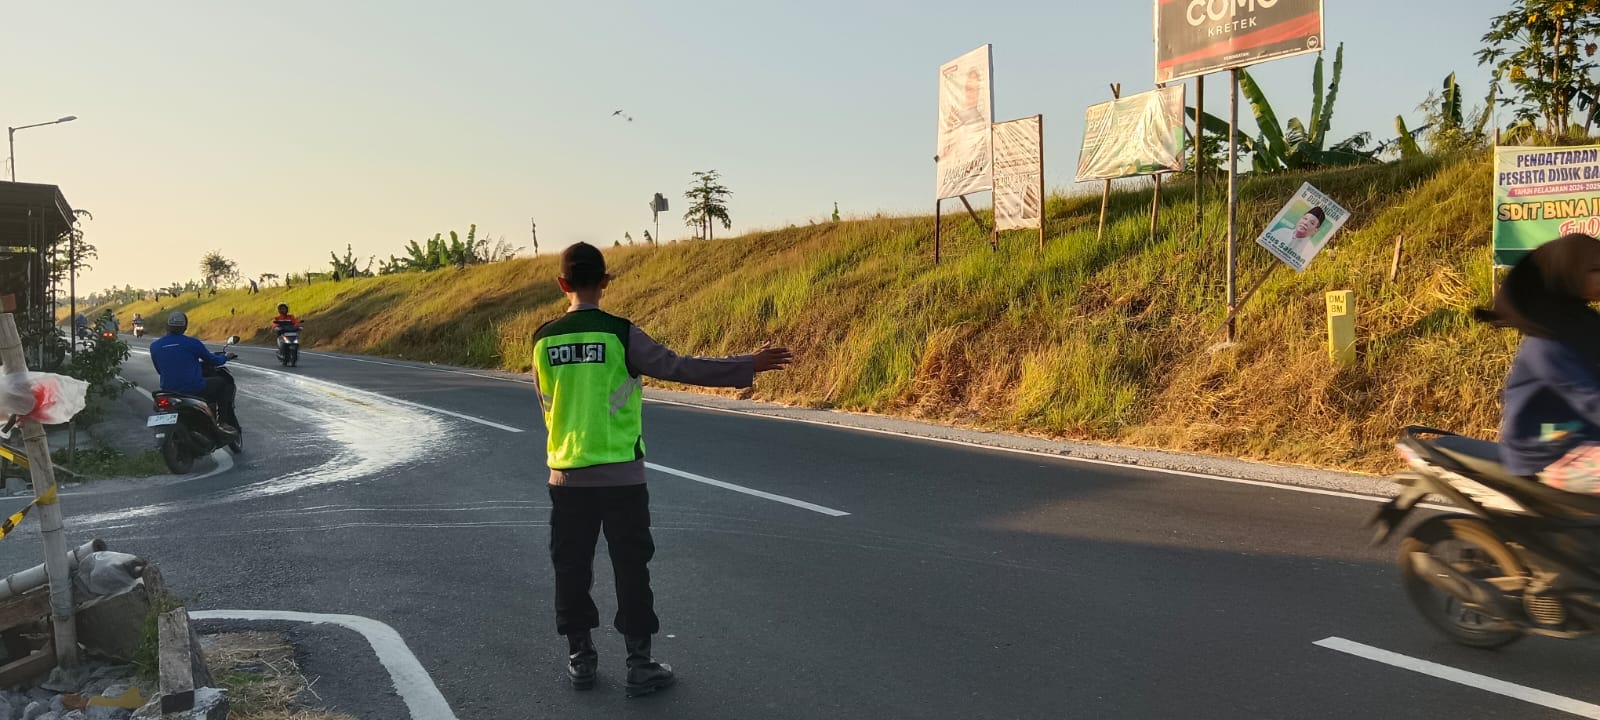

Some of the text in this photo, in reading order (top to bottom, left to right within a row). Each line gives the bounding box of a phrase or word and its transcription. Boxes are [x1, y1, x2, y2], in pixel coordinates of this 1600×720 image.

[1208, 16, 1257, 37] KRETEK
[1517, 149, 1598, 168] PENDAFTARAN
[1499, 169, 1546, 186] PESERTA
[1548, 167, 1581, 182] DIDIK
[1534, 185, 1568, 194] PELAJARAN
[1498, 197, 1600, 221] SDIT BINA I
[1265, 231, 1280, 245] Gus
[1278, 241, 1307, 265] Salman
[1329, 295, 1344, 303] DMJ
[548, 344, 603, 365] POLISI
